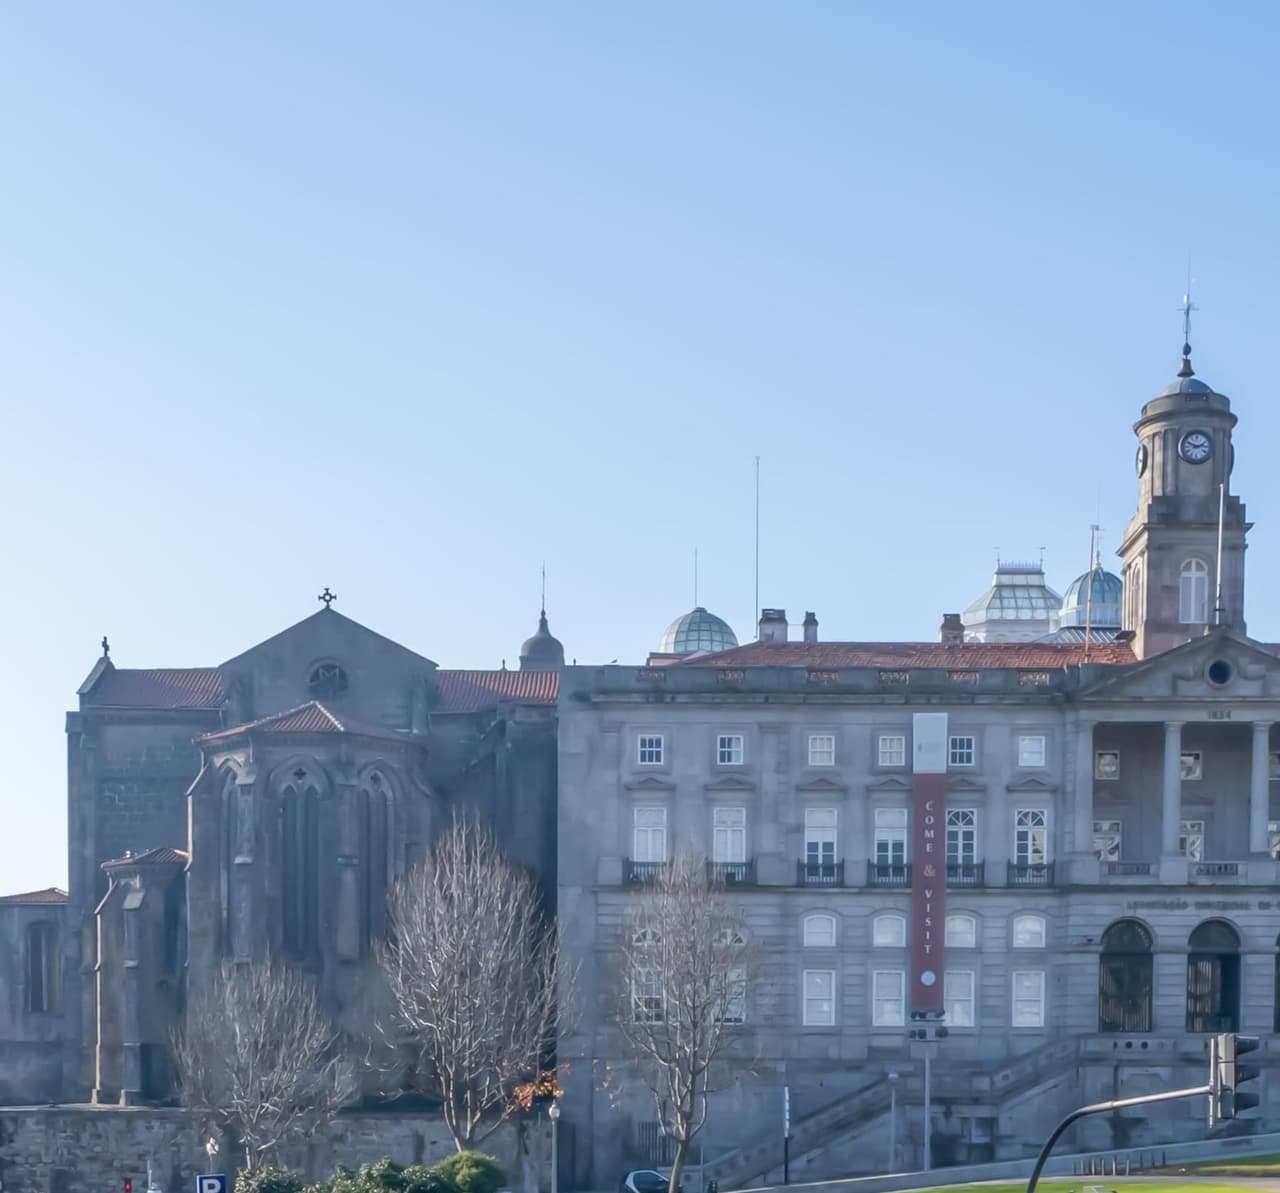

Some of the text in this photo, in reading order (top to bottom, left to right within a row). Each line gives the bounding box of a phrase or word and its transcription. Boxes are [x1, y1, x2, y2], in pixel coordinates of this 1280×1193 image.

[923, 801, 936, 953] COME & VISIT
